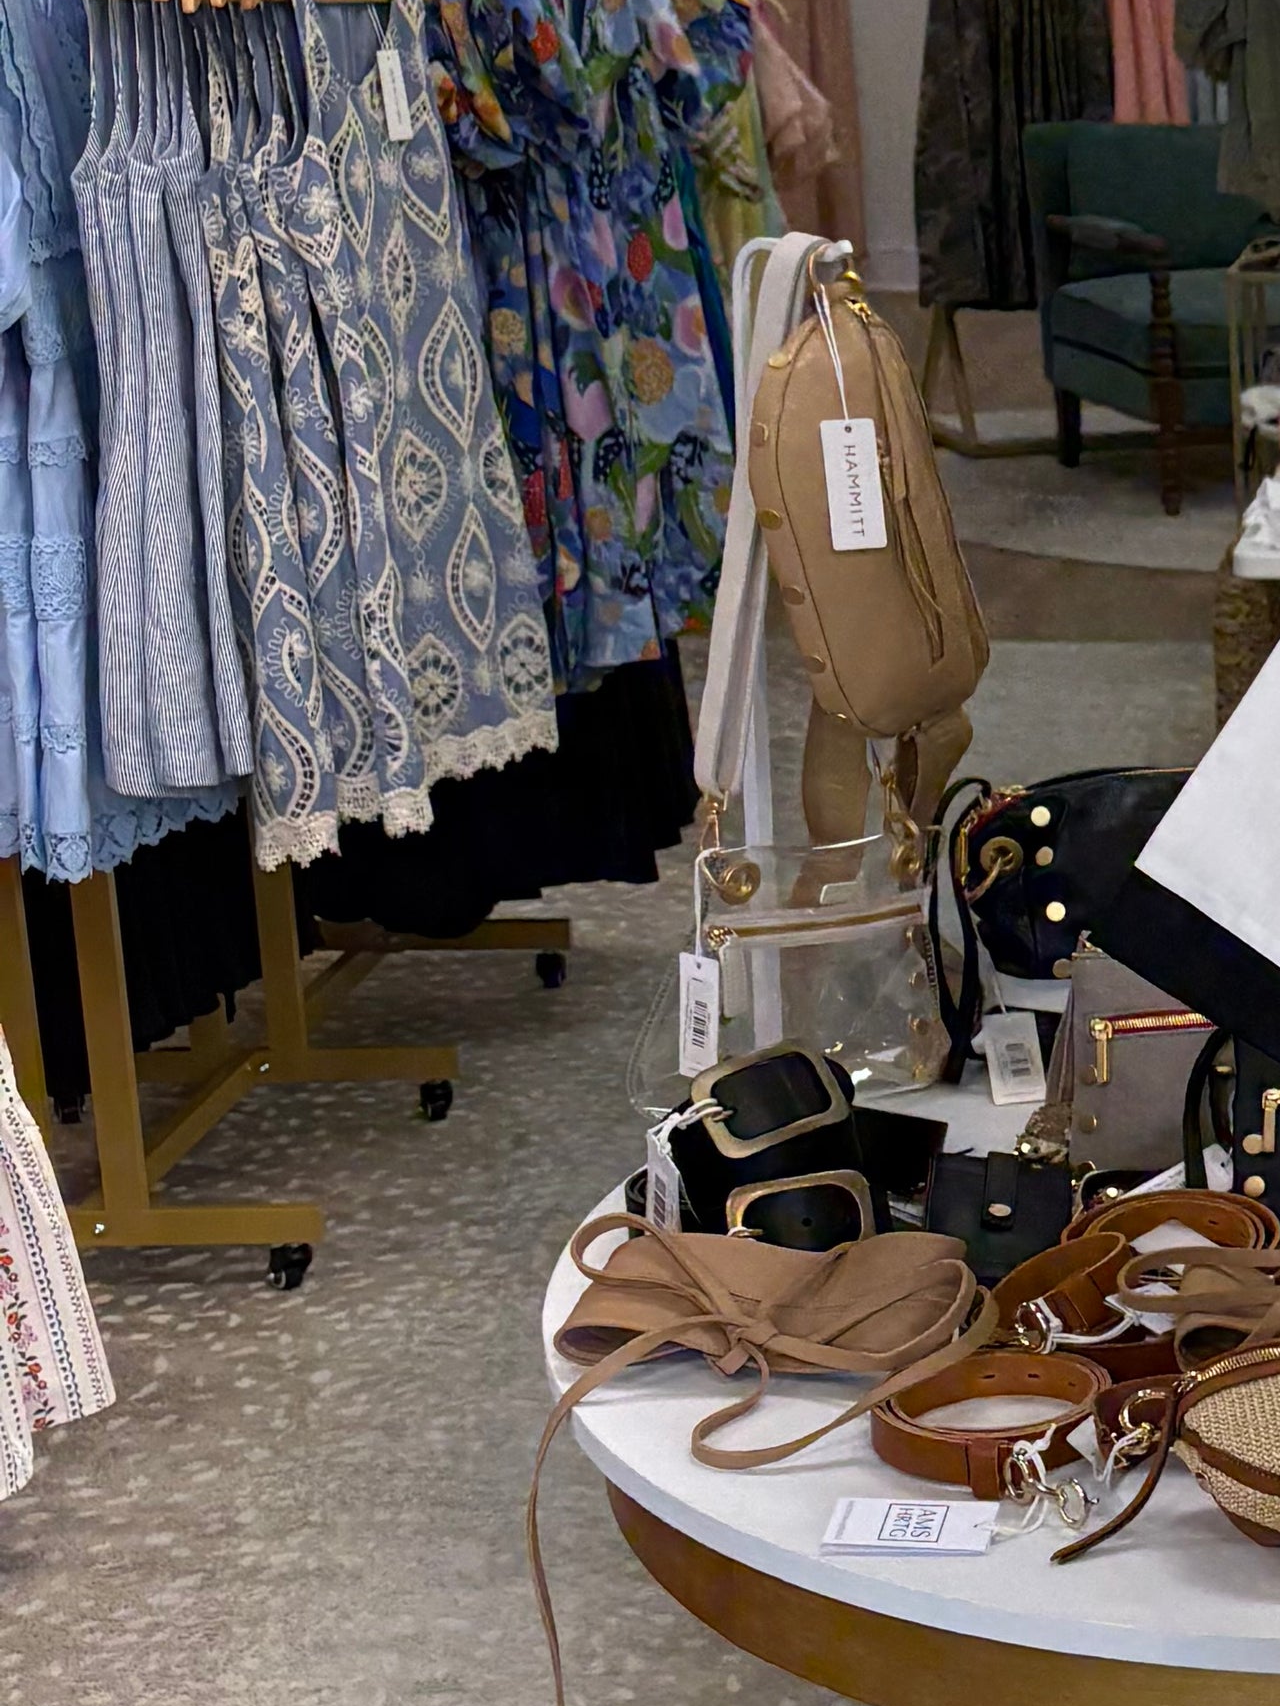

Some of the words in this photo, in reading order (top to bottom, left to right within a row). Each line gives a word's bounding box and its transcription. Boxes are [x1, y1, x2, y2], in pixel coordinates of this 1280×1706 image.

[843, 444, 866, 537] HAMMITT
[889, 1507, 915, 1539] HRTG
[910, 1507, 938, 1539] AMS
